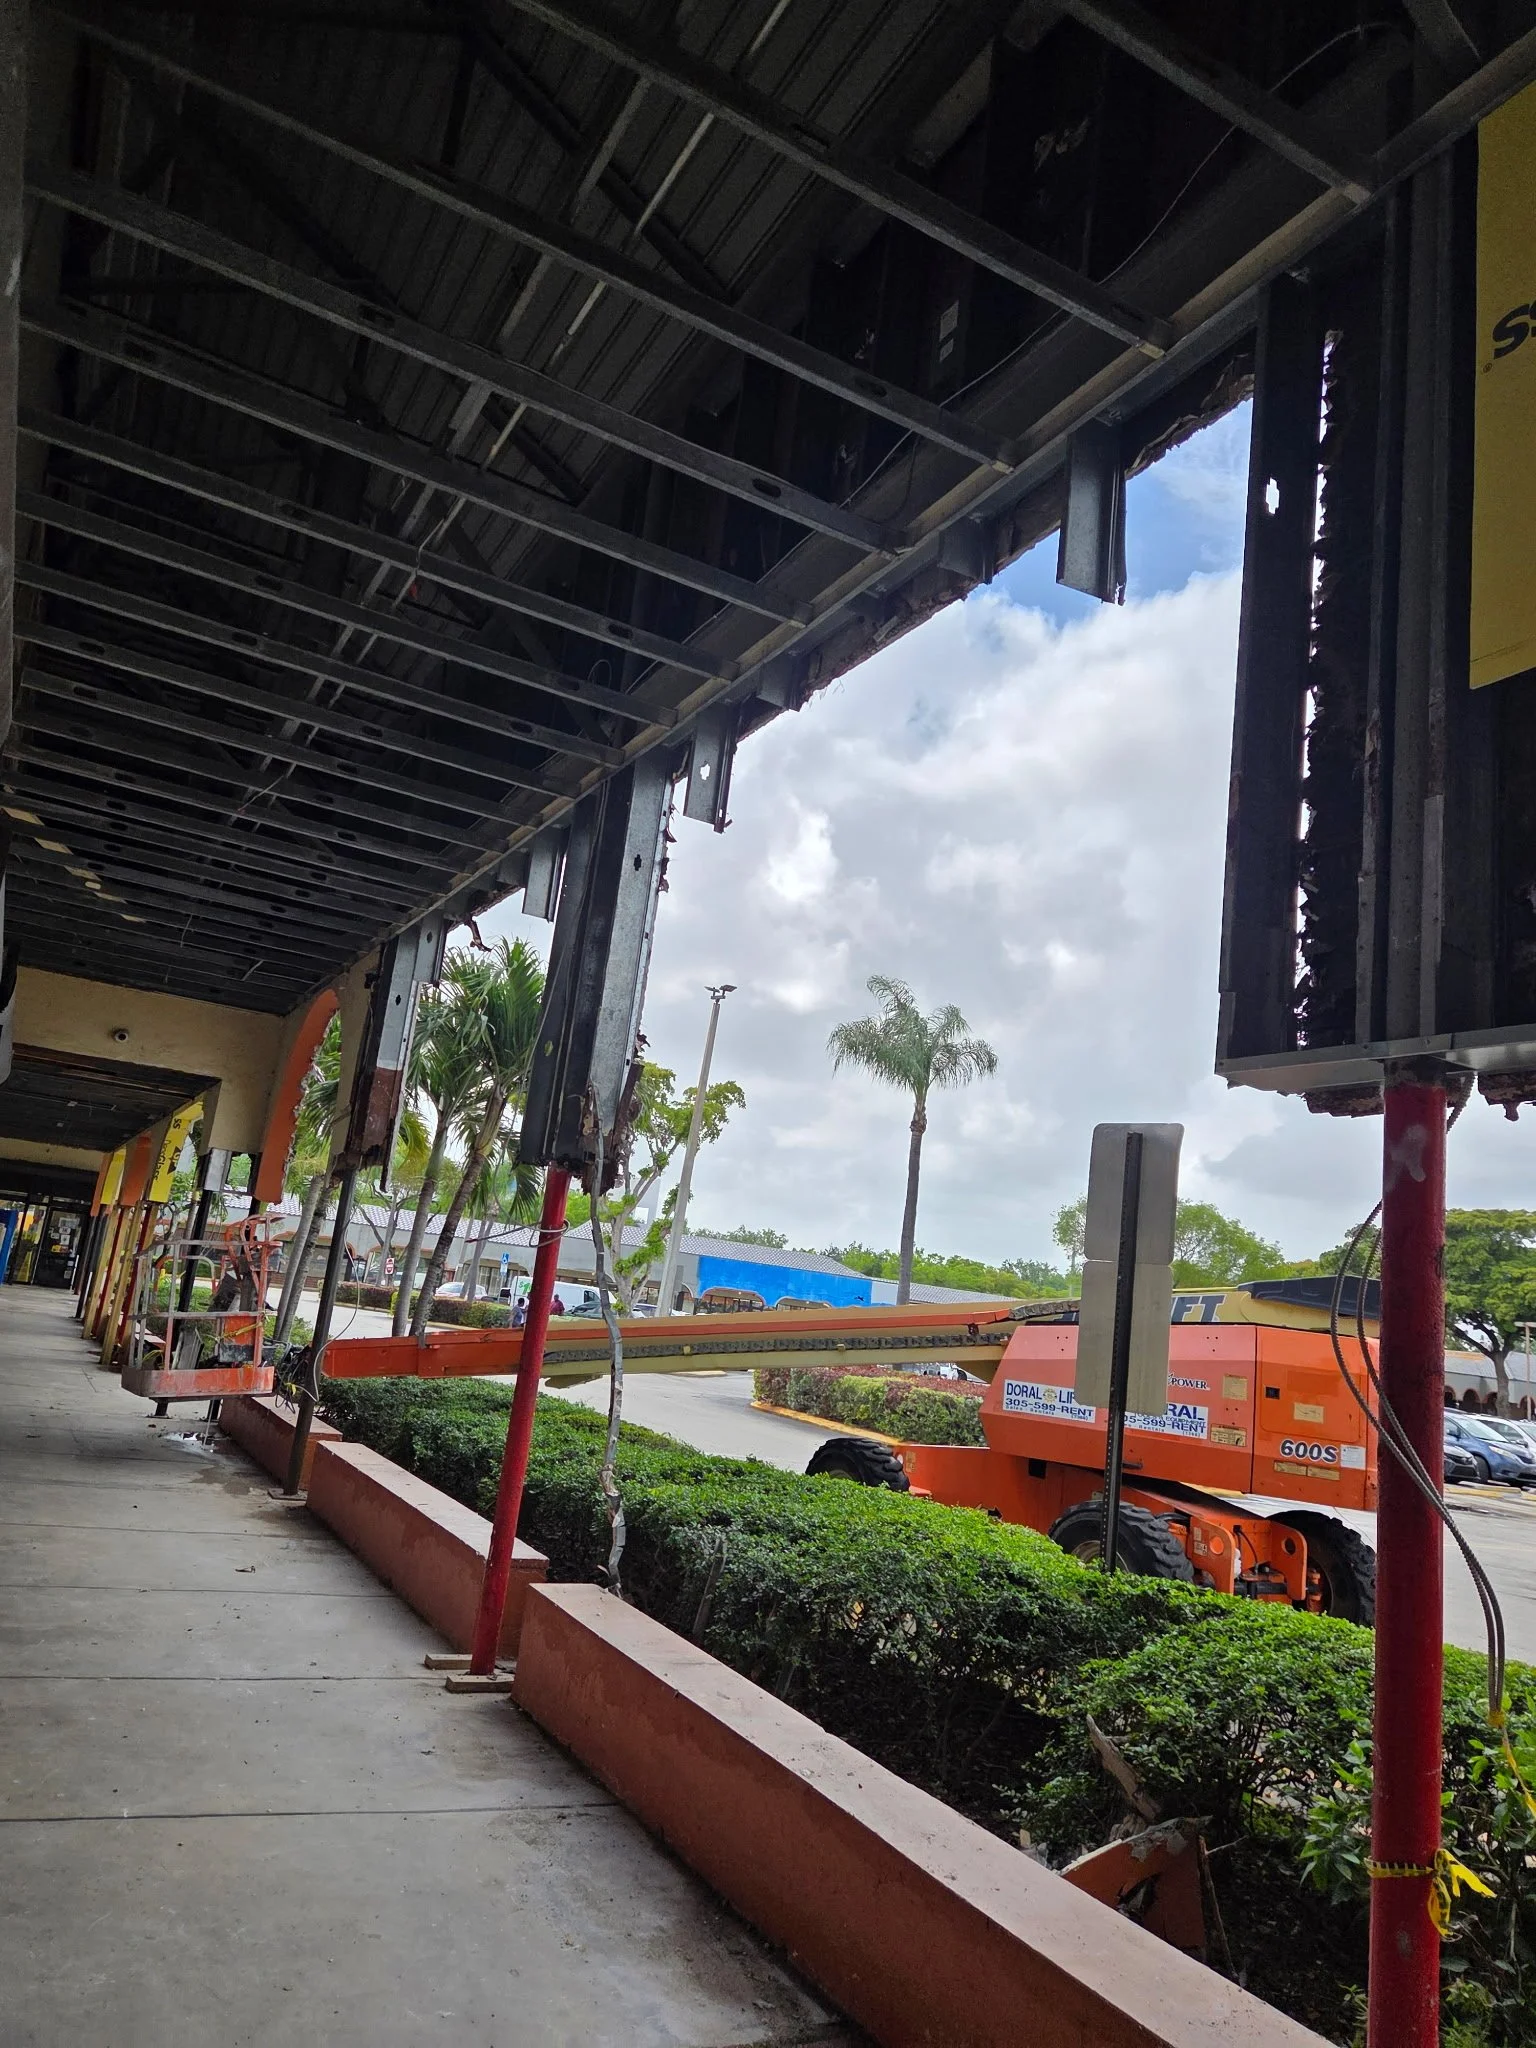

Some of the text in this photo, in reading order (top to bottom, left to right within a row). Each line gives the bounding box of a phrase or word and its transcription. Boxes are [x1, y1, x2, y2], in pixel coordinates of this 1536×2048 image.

[1006, 1382, 1043, 1400] DORAL
[1005, 1398, 1094, 1417] 305-599-RENT
[1164, 1403, 1205, 1421] RAL
[1280, 1439, 1339, 1464] 600S
